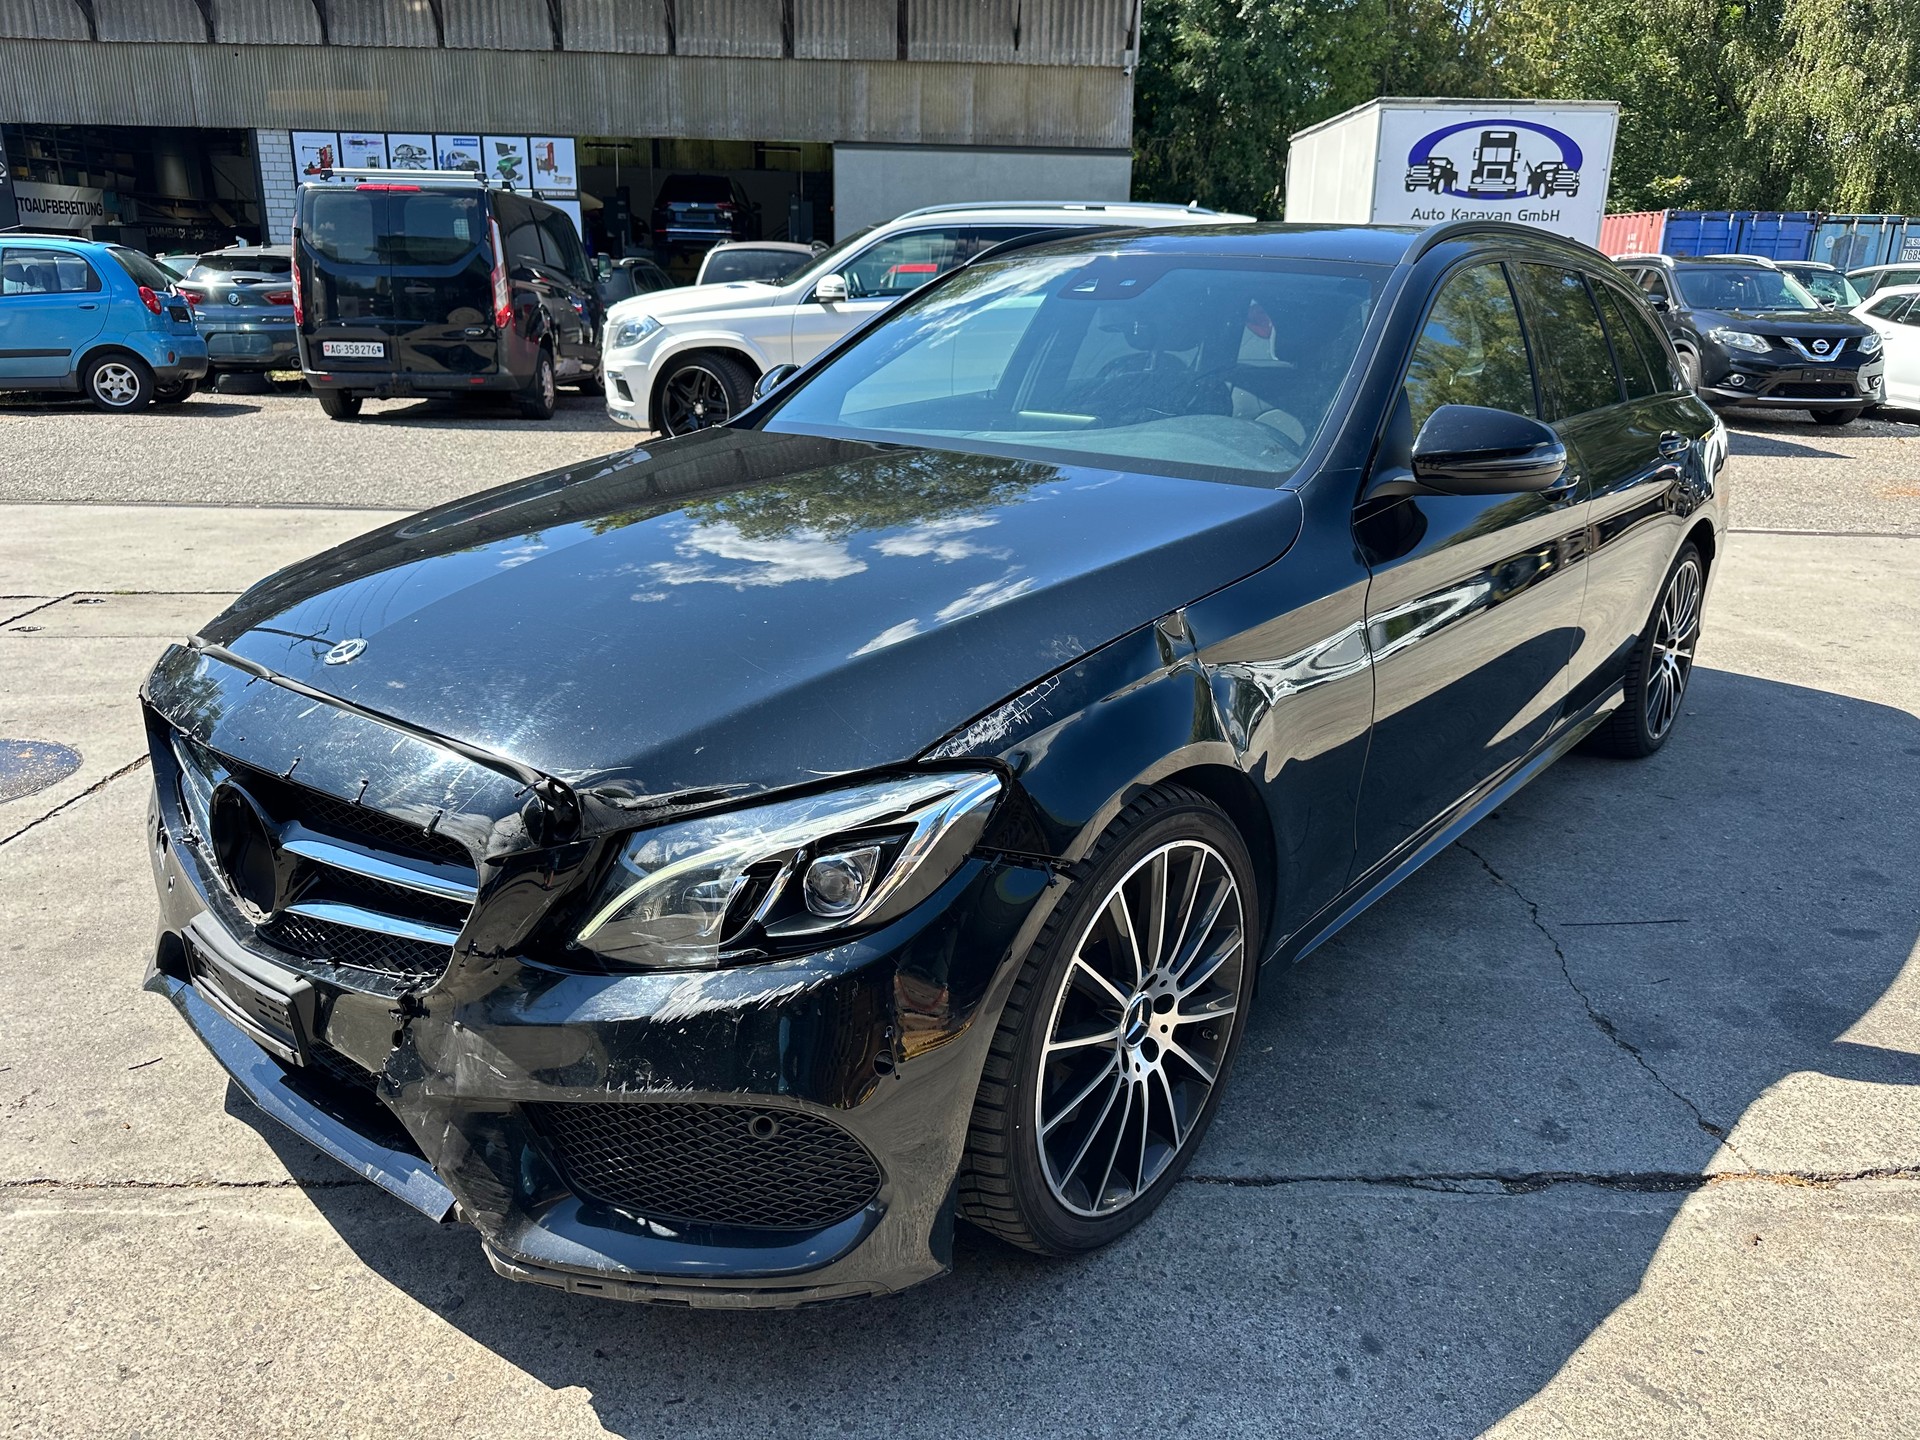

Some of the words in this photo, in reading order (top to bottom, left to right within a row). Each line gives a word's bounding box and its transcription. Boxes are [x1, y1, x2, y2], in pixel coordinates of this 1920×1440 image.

[16, 197, 103, 216] TOAUFBEREITUNG
[1411, 208, 1445, 220] Auto
[1451, 208, 1512, 221] Karavan
[1517, 209, 1560, 222] GmbH
